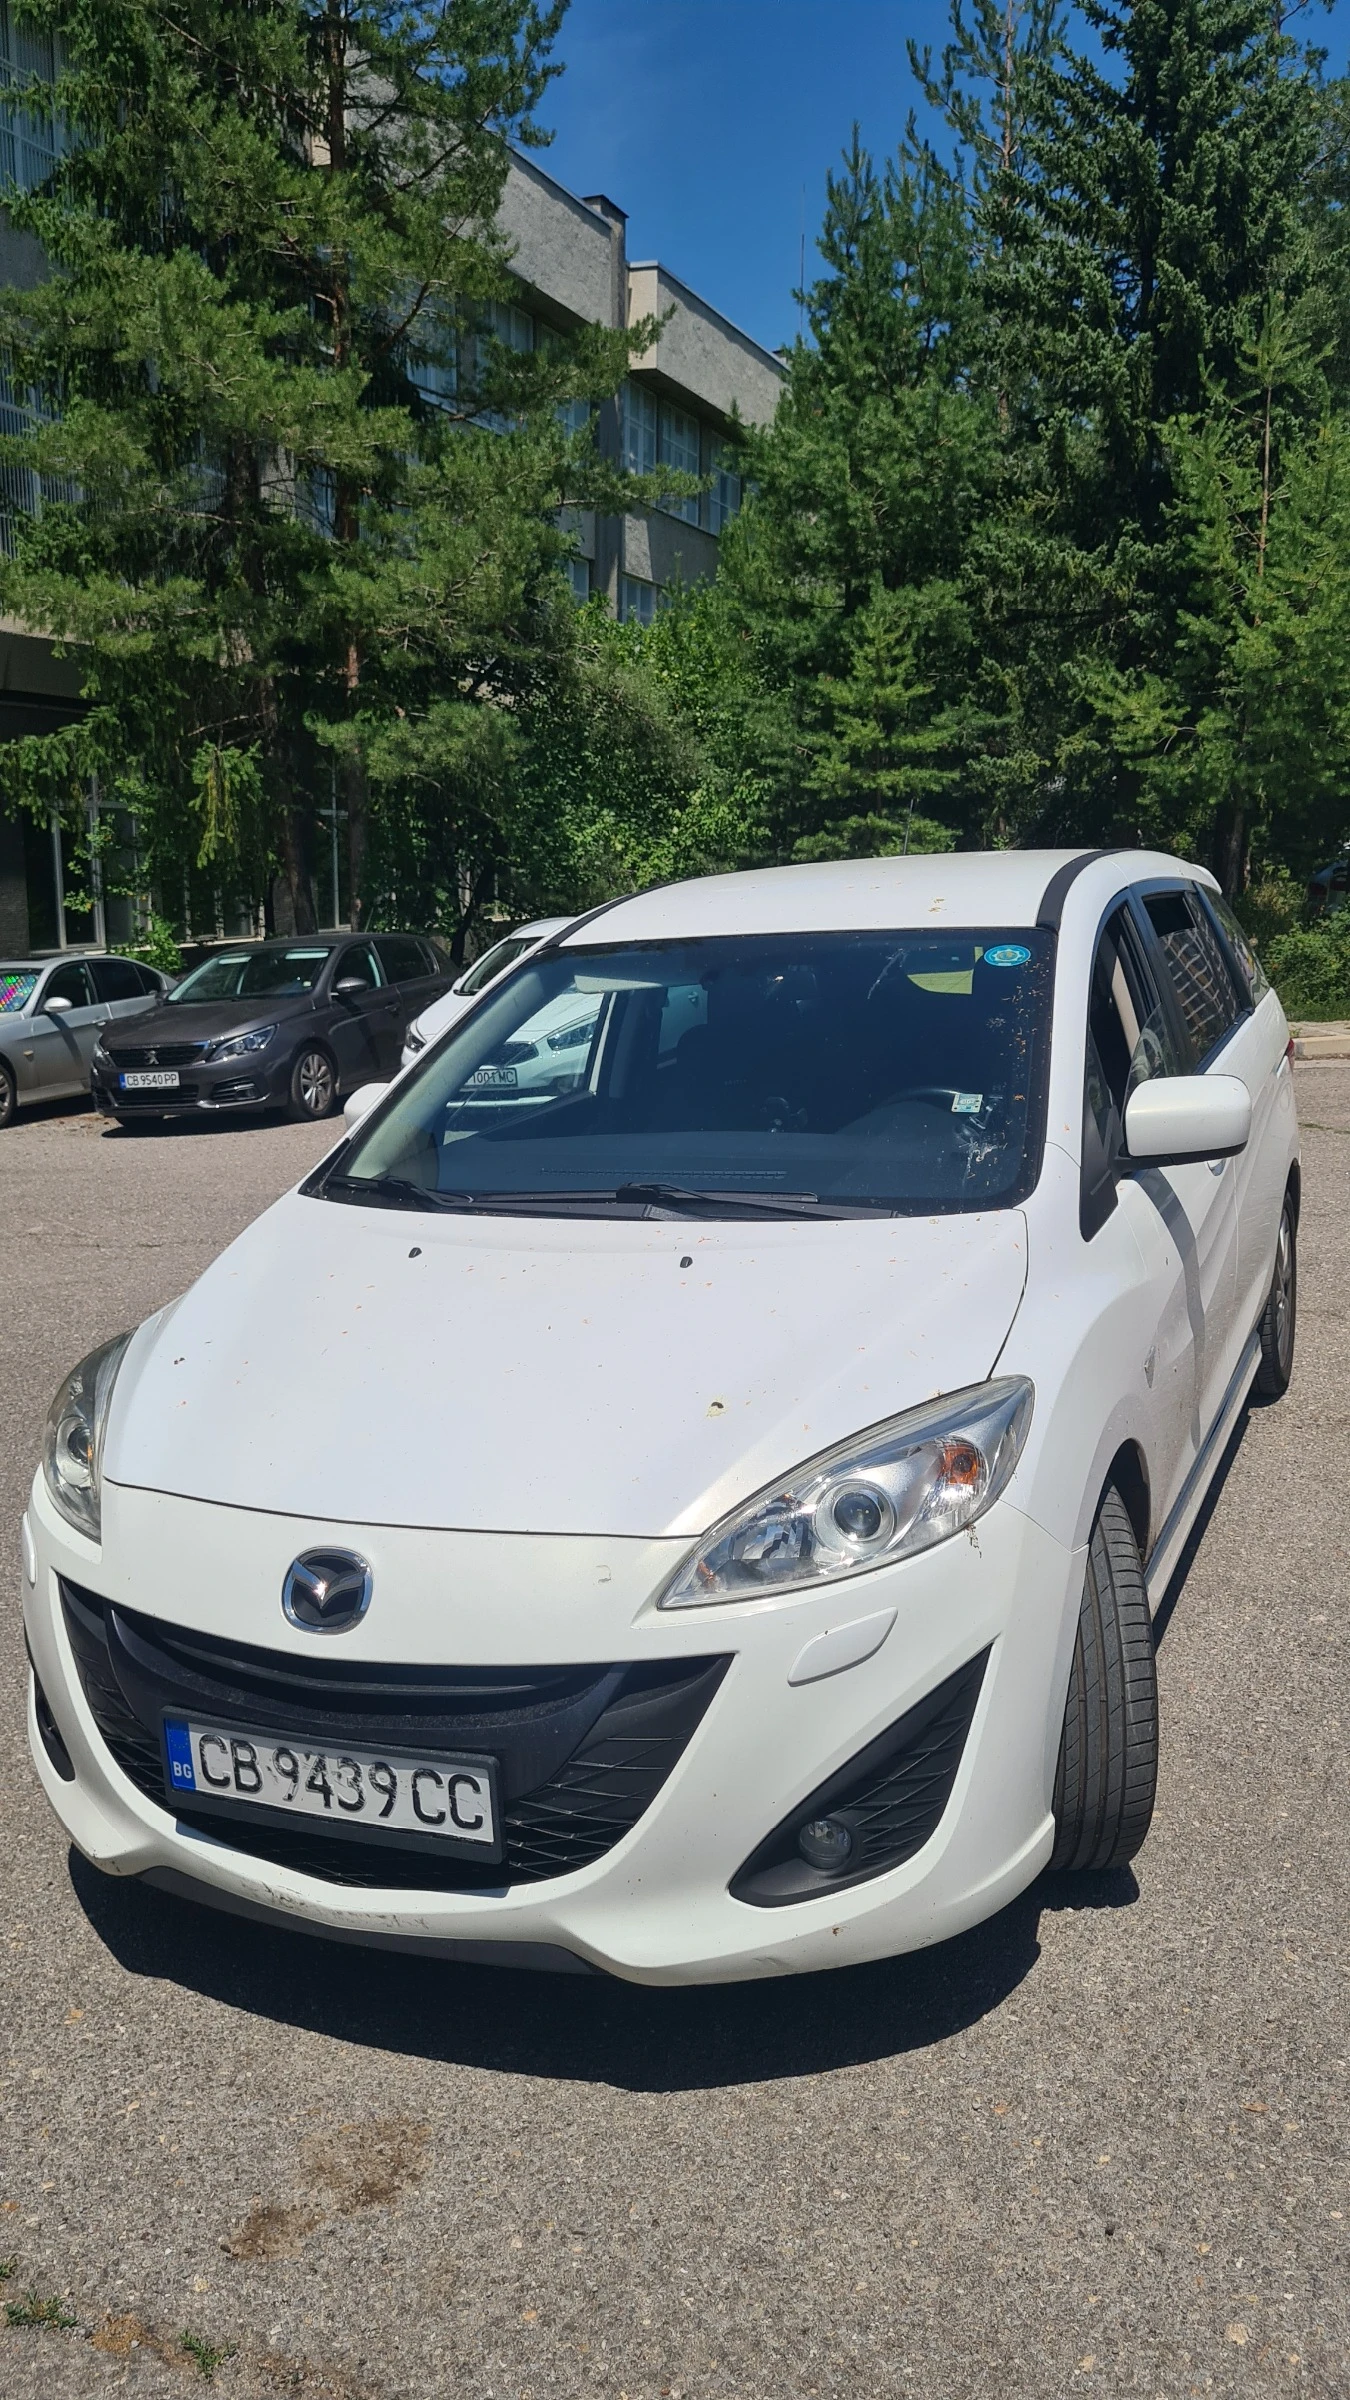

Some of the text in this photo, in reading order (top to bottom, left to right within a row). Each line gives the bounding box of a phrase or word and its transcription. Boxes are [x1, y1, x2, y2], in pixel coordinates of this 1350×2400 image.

[126, 1075, 139, 1086] CB
[140, 1074, 163, 1085] 9540
[164, 1073, 177, 1084] PP
[173, 1733, 484, 1829] BG CB 9439 CC
